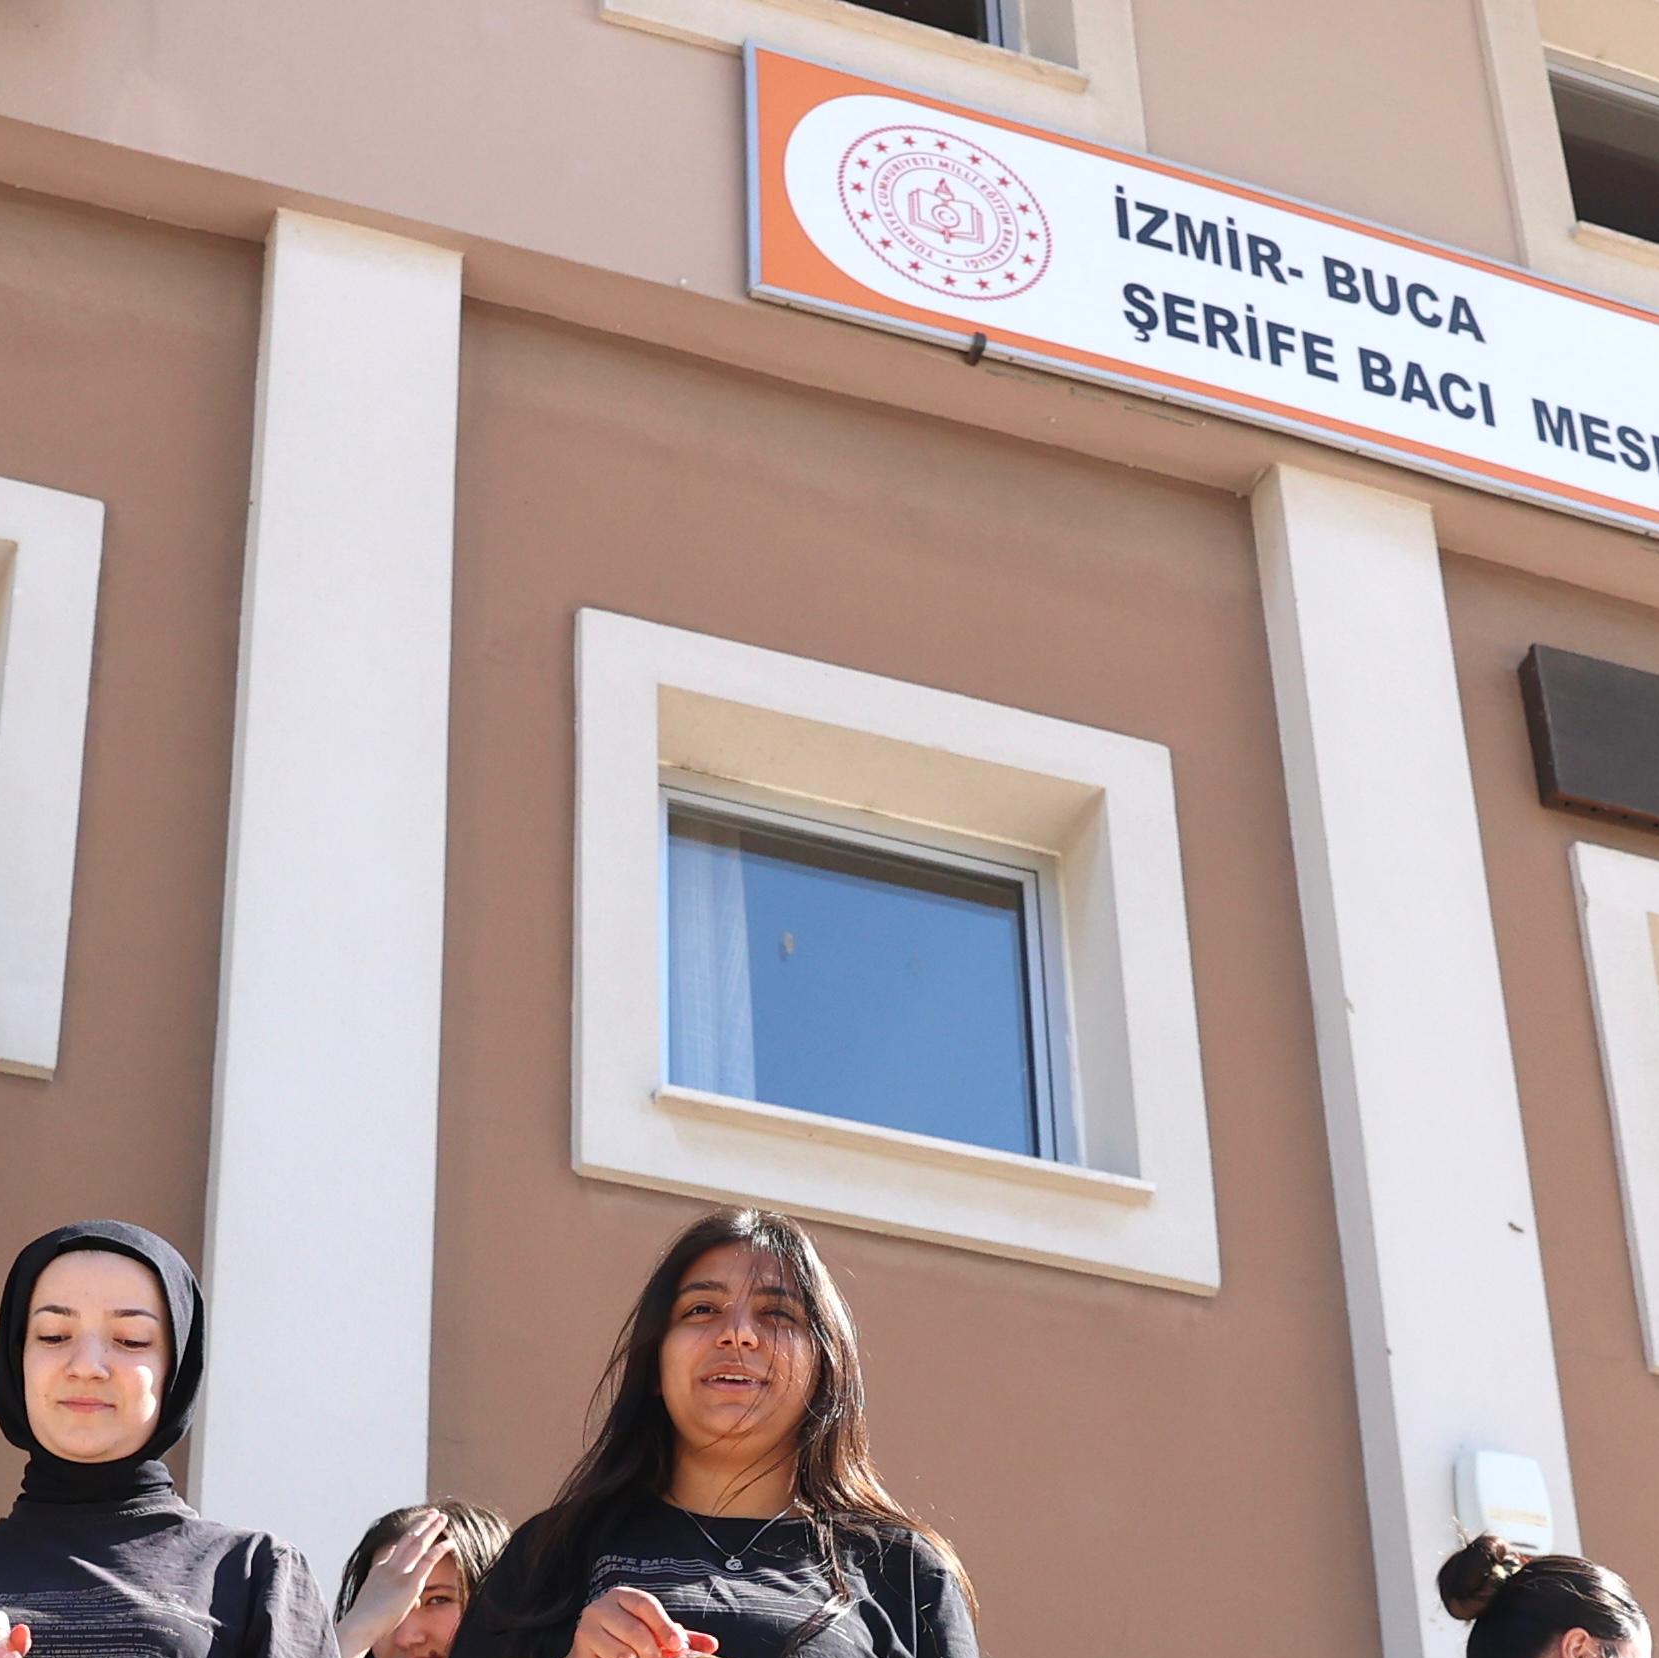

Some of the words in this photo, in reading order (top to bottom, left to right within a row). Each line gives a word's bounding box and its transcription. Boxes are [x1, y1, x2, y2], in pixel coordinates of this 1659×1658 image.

[1114, 184, 1304, 285] İZMİR-
[1325, 254, 1486, 344] BUCA
[1122, 281, 1338, 384] ŞERİFE
[1359, 348, 1497, 428] BACI
